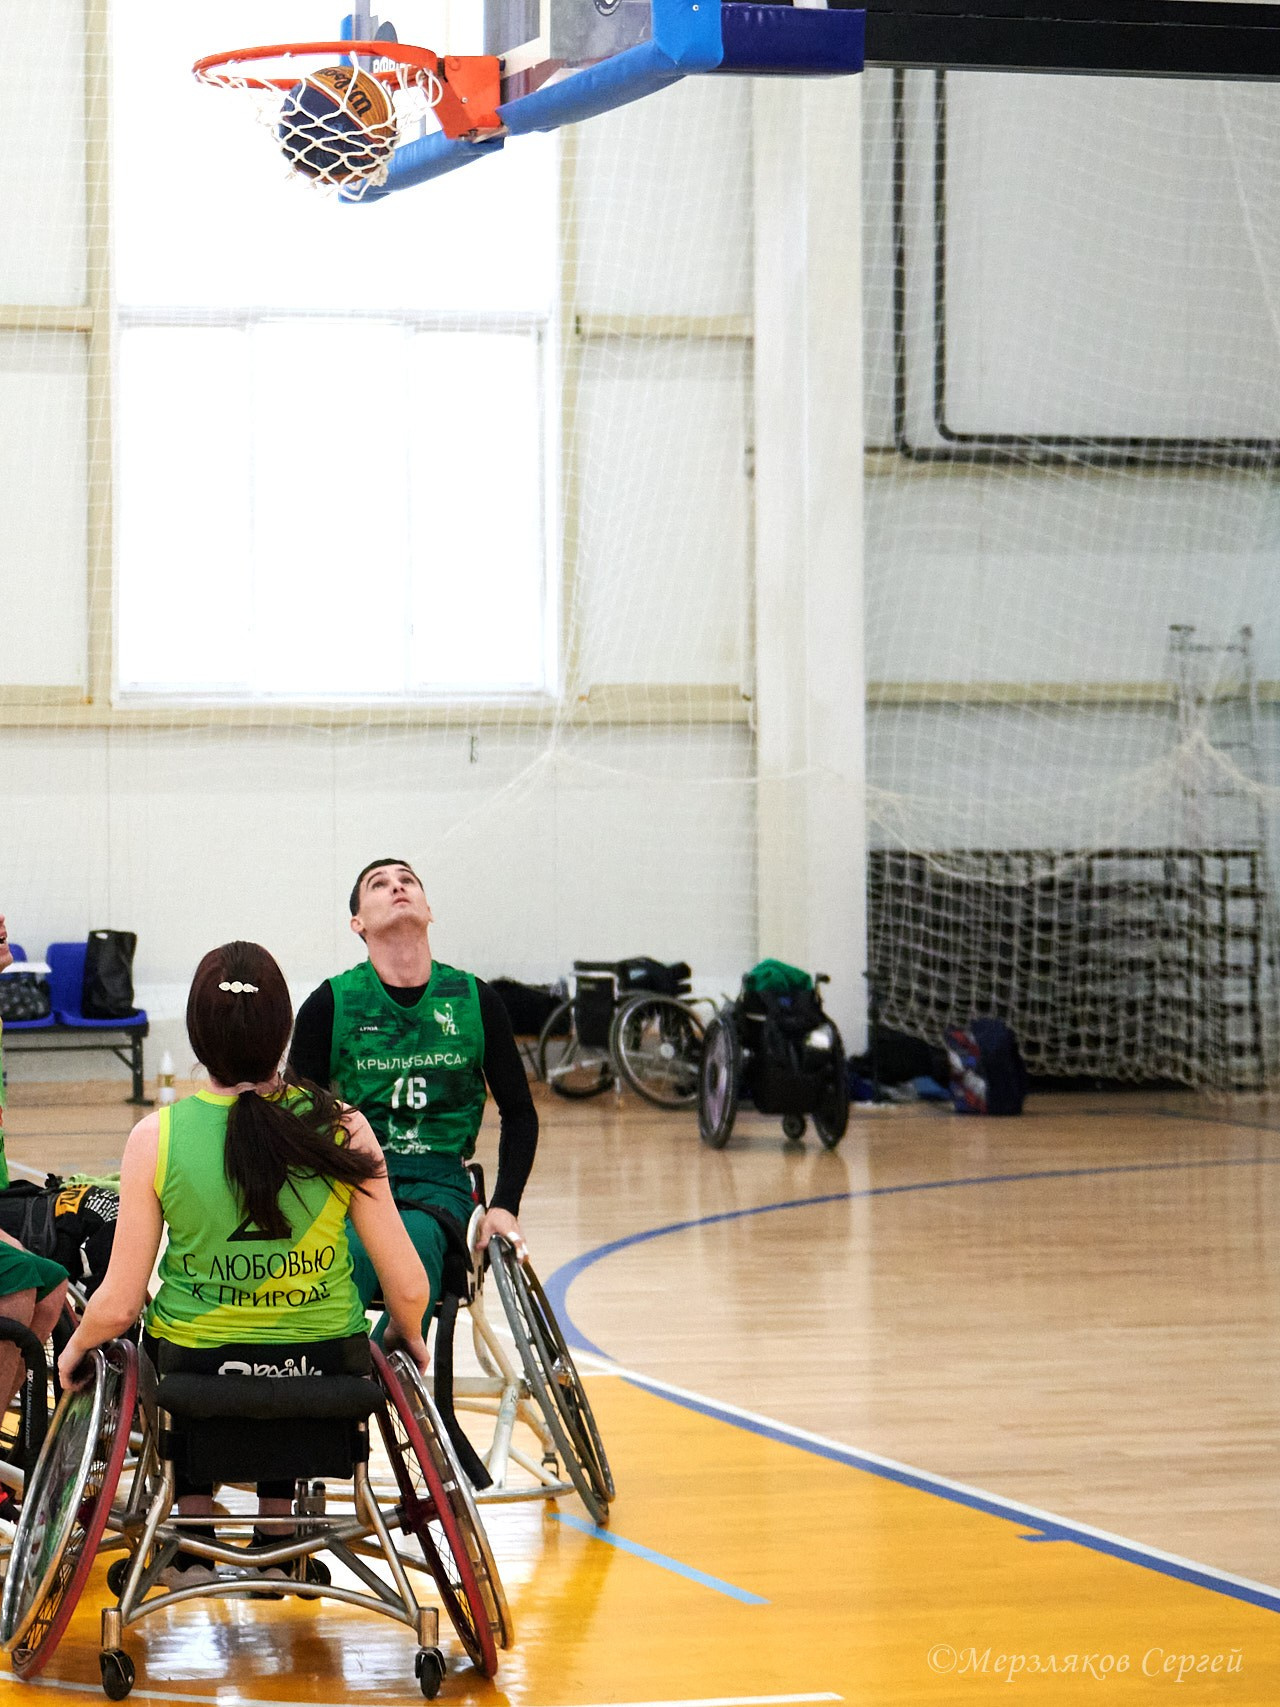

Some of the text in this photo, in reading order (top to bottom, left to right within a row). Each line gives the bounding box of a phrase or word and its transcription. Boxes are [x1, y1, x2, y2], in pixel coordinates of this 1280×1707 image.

[391, 1077, 428, 1110] 16
[183, 1245, 336, 1282] С ЛЮБОВЬЮ
[192, 1281, 331, 1307] К ПРИРОДЕ
